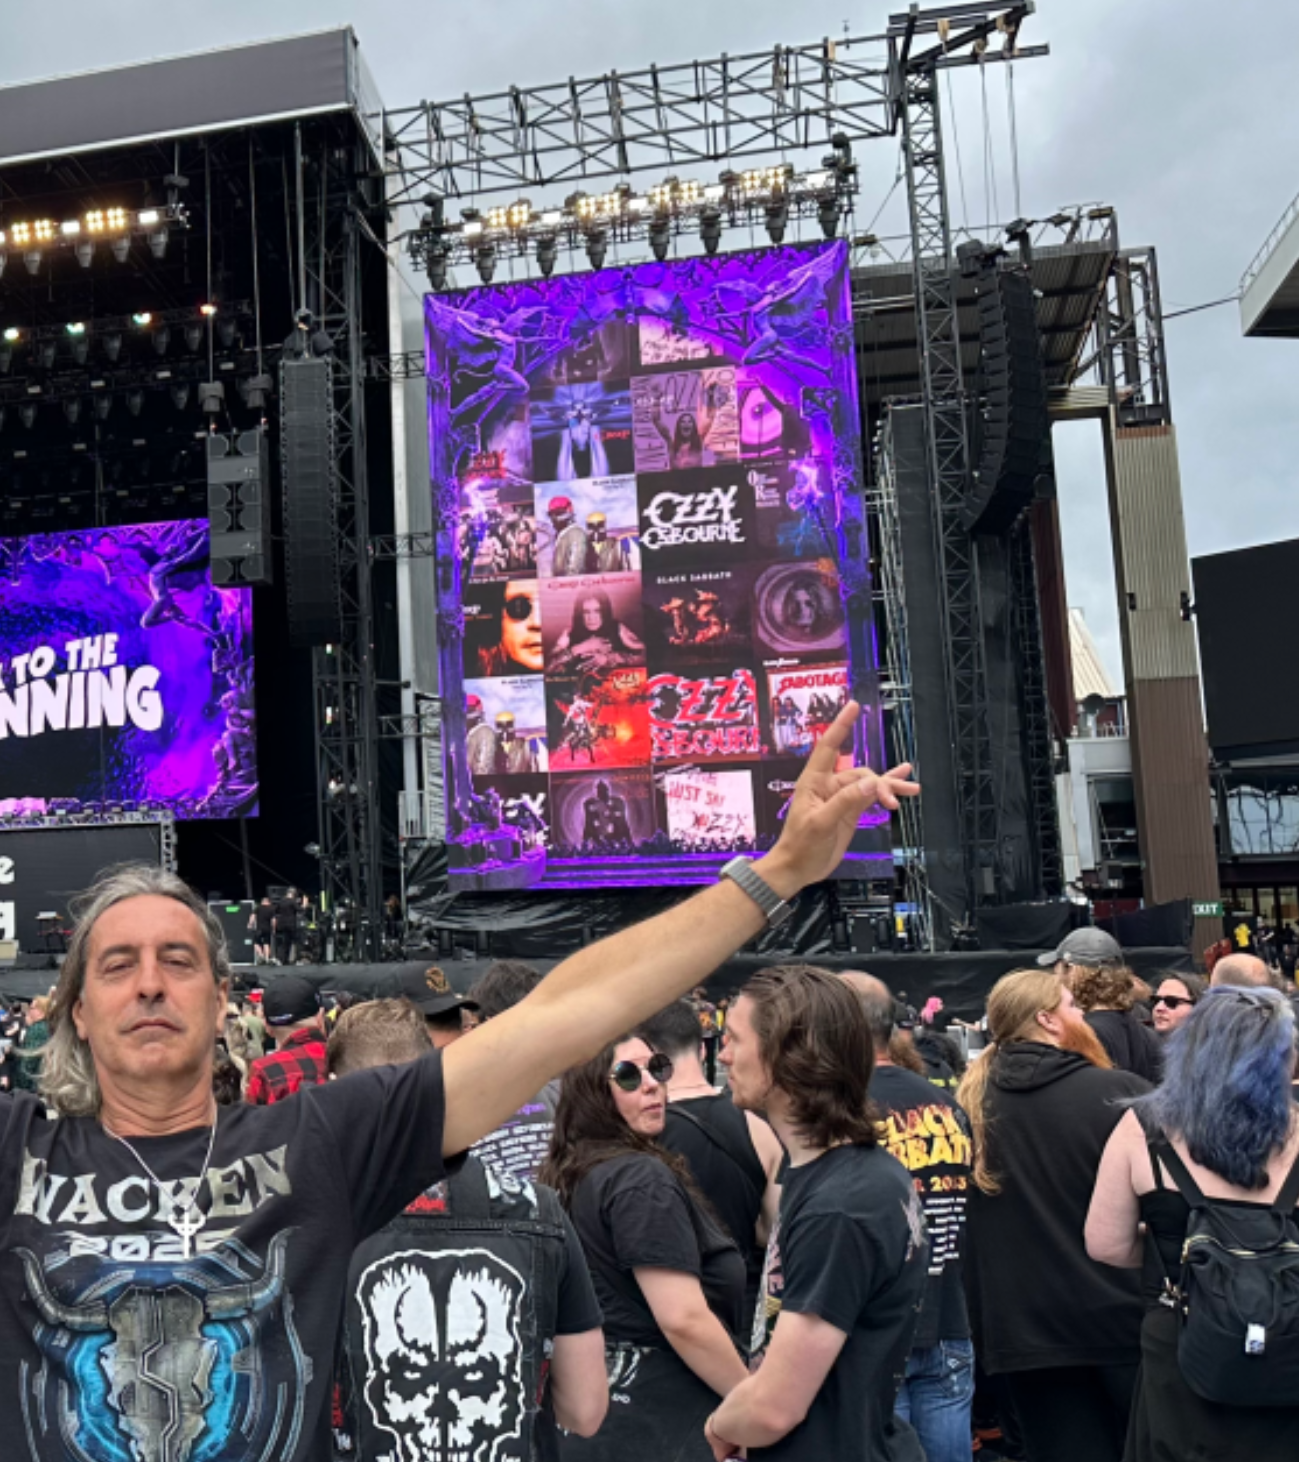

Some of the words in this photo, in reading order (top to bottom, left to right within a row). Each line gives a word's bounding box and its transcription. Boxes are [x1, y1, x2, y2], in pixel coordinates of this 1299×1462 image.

[643, 485, 738, 527] OZZY
[640, 518, 746, 550] OSBOURNE
[11, 646, 56, 686] TO
[65, 632, 119, 671] THE
[874, 1104, 963, 1143] LACK
[13, 1144, 293, 1225] WACKEN
